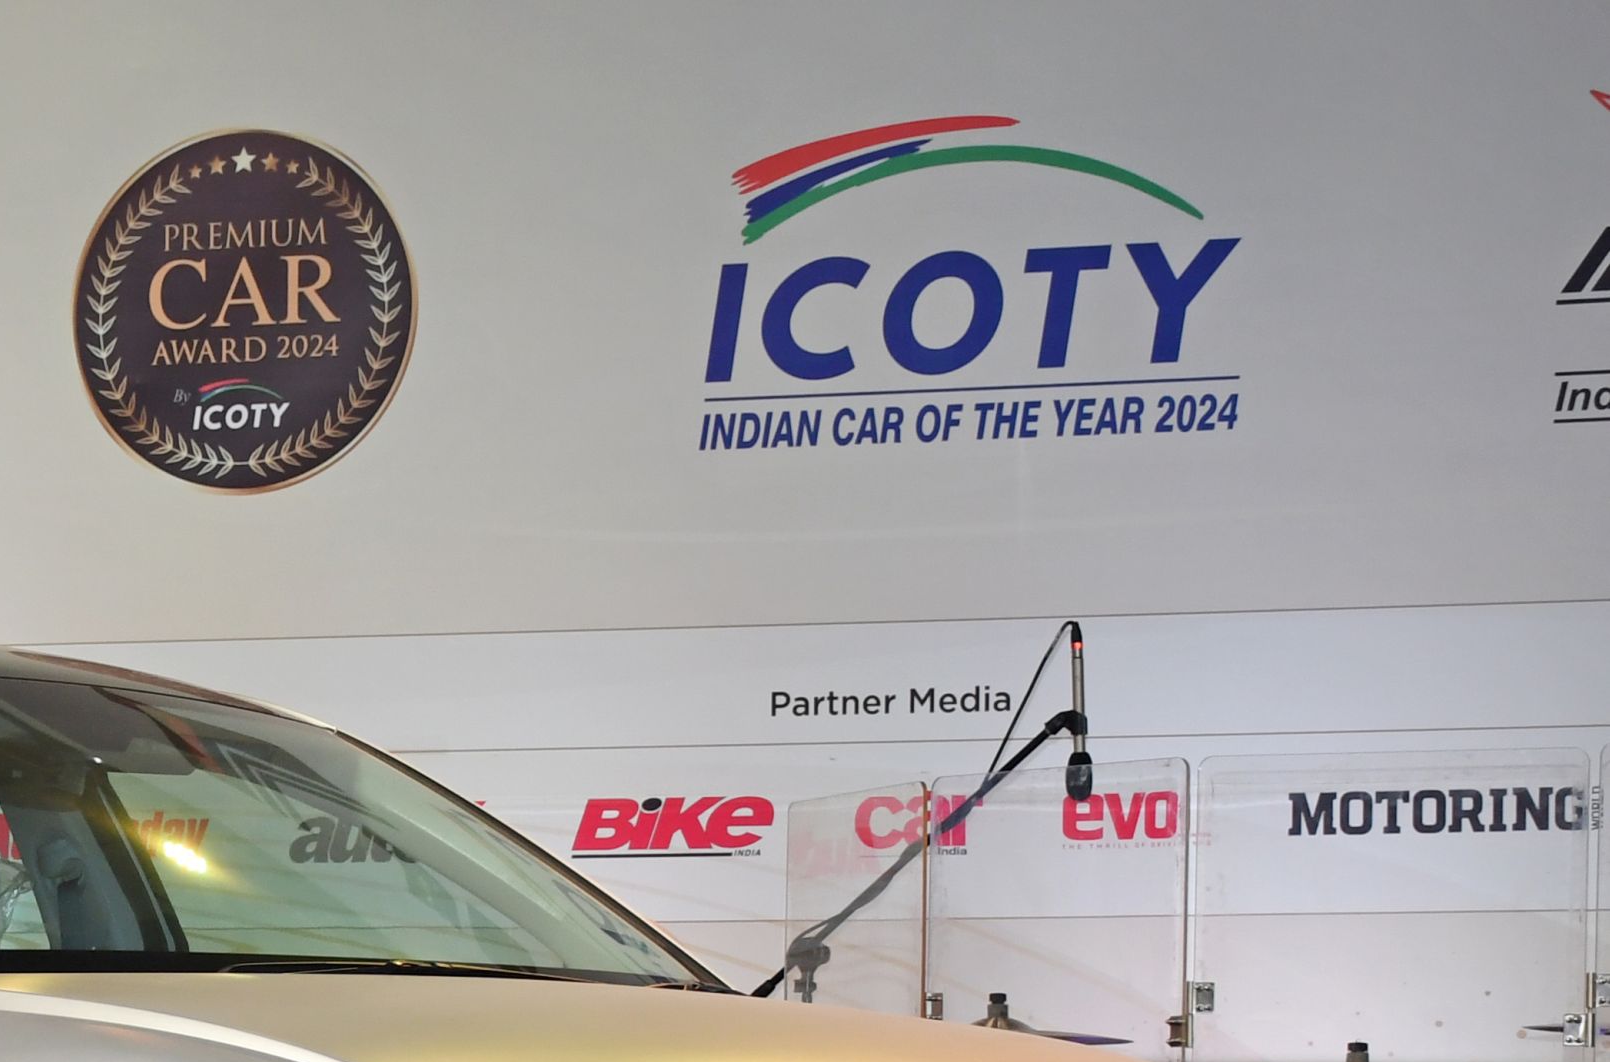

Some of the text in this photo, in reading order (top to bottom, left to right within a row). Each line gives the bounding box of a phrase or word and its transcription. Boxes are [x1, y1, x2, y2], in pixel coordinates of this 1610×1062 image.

[163, 217, 328, 252] PREMIUM
[148, 254, 341, 330] CAR
[704, 237, 1242, 383] ICOTY
[151, 334, 340, 367] AWARD 2024
[173, 389, 191, 406] By
[192, 401, 290, 431] ICOTY
[698, 393, 1240, 451] INDIAN CAR OF THE YEAR 2024
[771, 685, 1011, 717] Partner Media
[1063, 791, 1179, 840] evo
[1288, 787, 1583, 836] MOTORING
